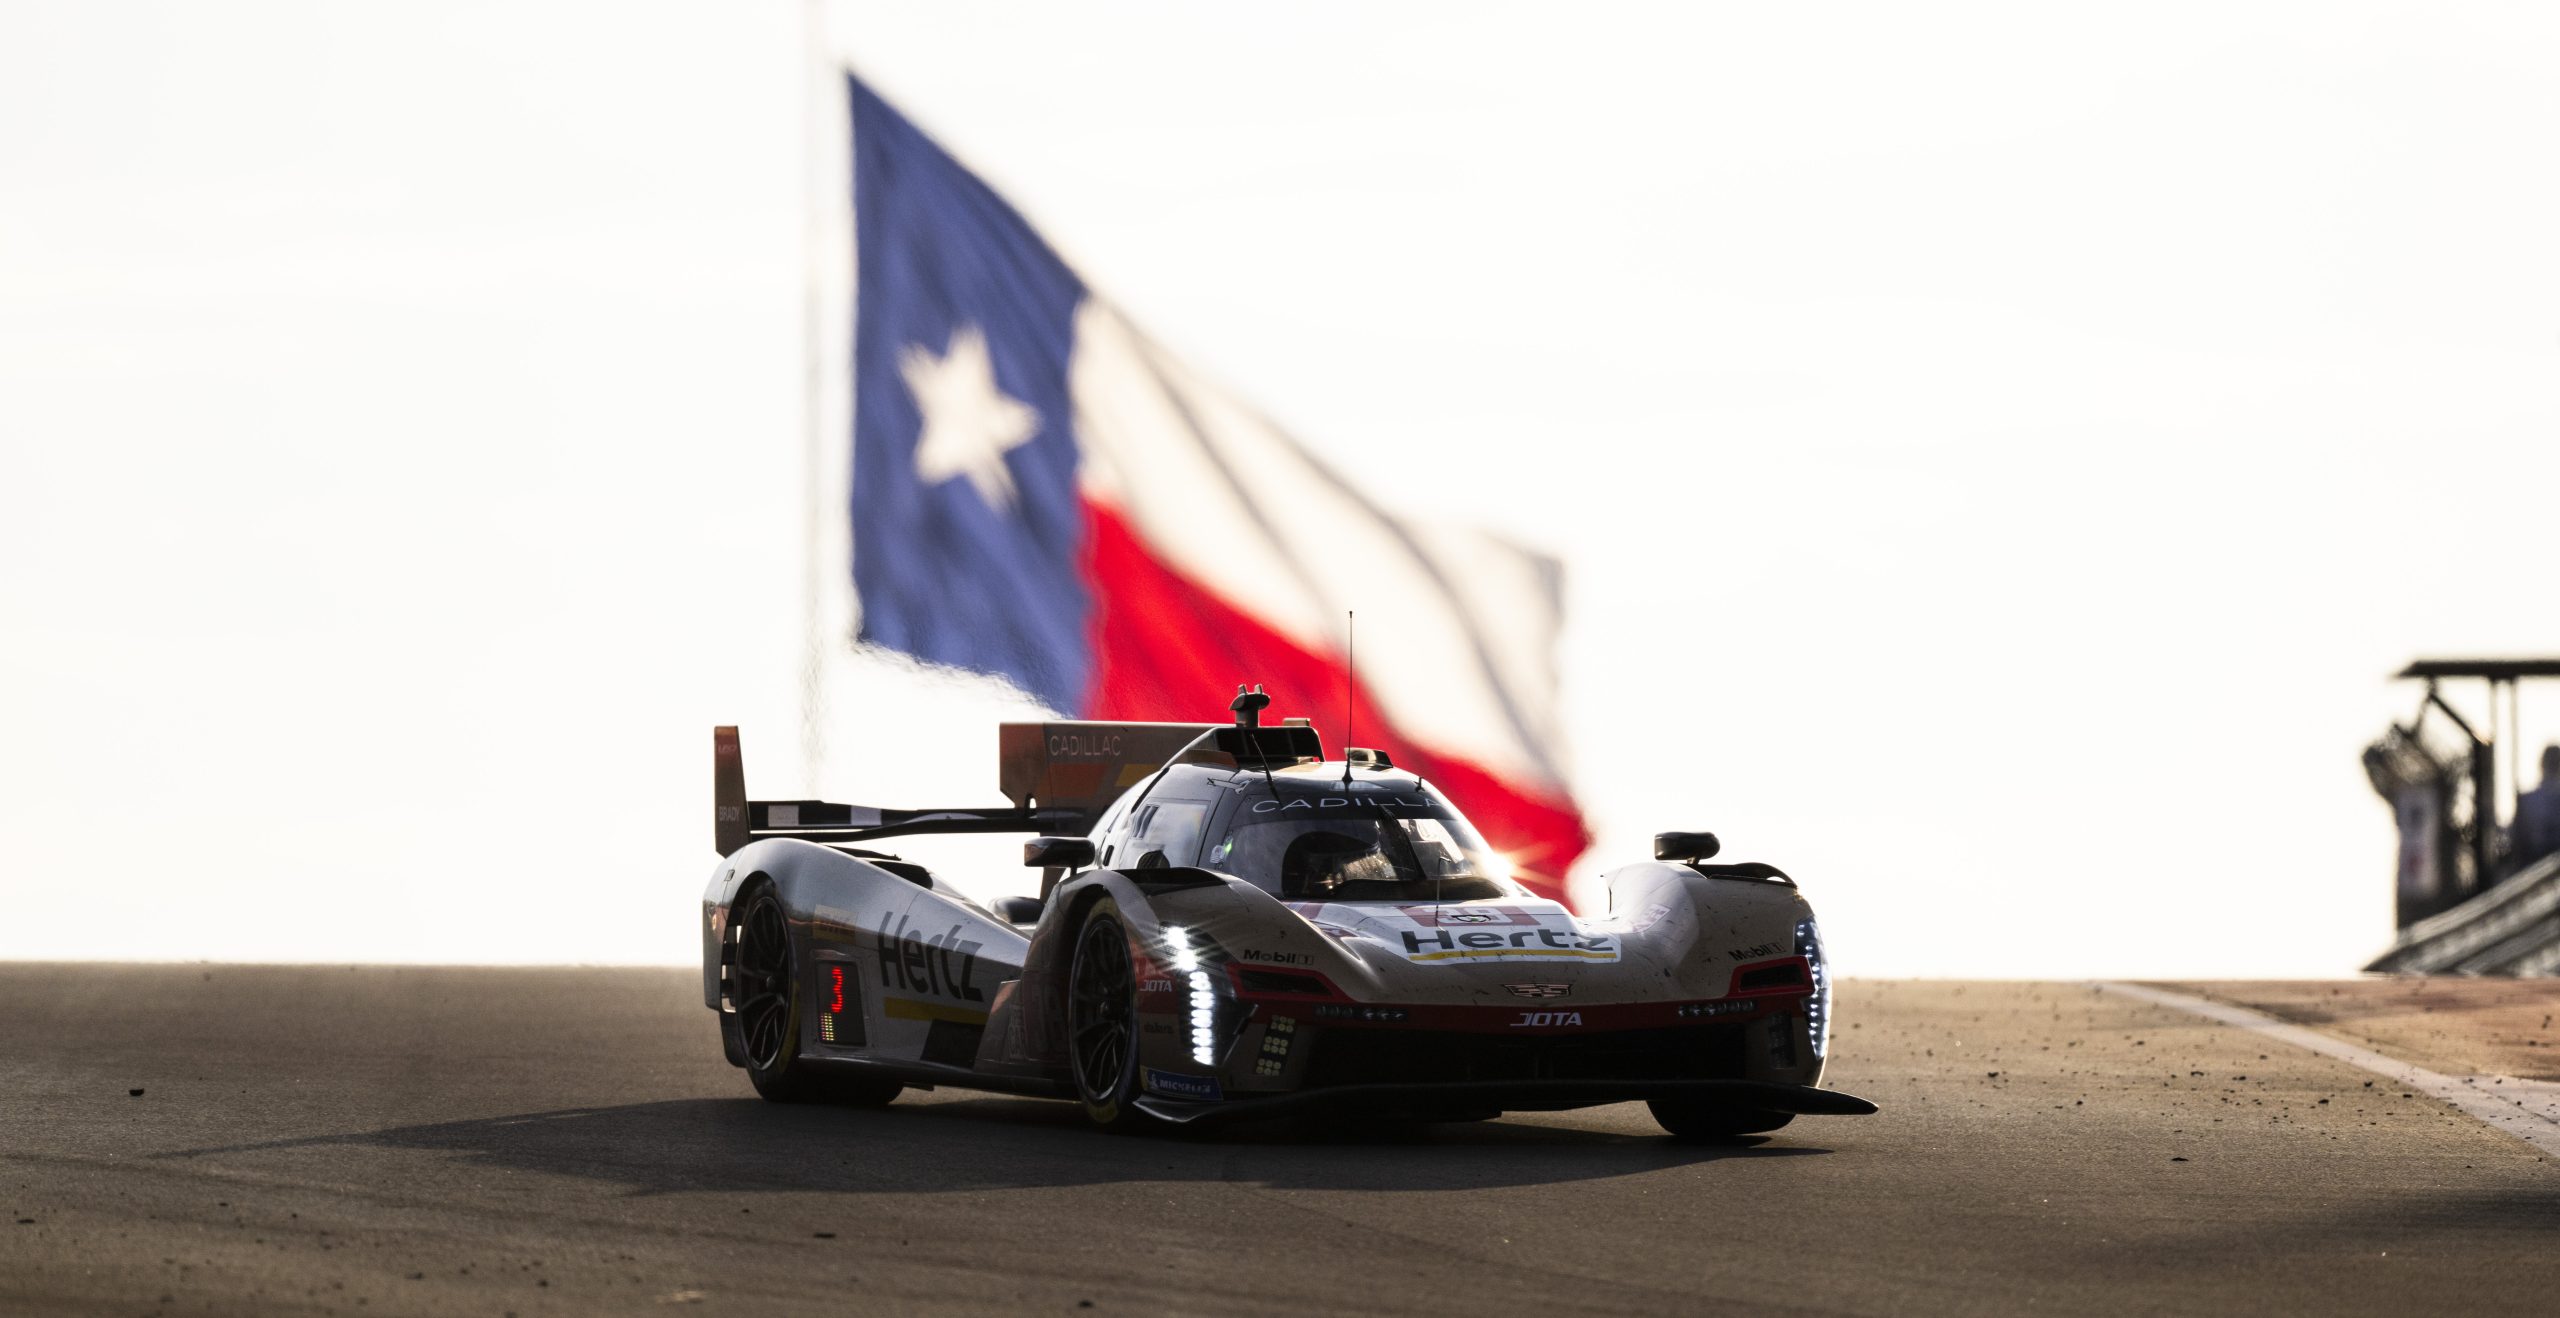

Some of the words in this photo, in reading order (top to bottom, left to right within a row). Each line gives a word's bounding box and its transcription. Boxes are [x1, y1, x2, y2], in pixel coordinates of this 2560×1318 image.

[1050, 735, 1121, 756] CADILLAC
[1401, 929, 1614, 953] Hertz
[878, 911, 984, 1002] Hertz
[1243, 949, 1296, 964] Mobil
[1728, 944, 1773, 961] Mobil
[831, 966, 843, 1013] 3
[1140, 979, 1173, 992] JOTA
[1510, 1012, 1583, 1026] JOTA
